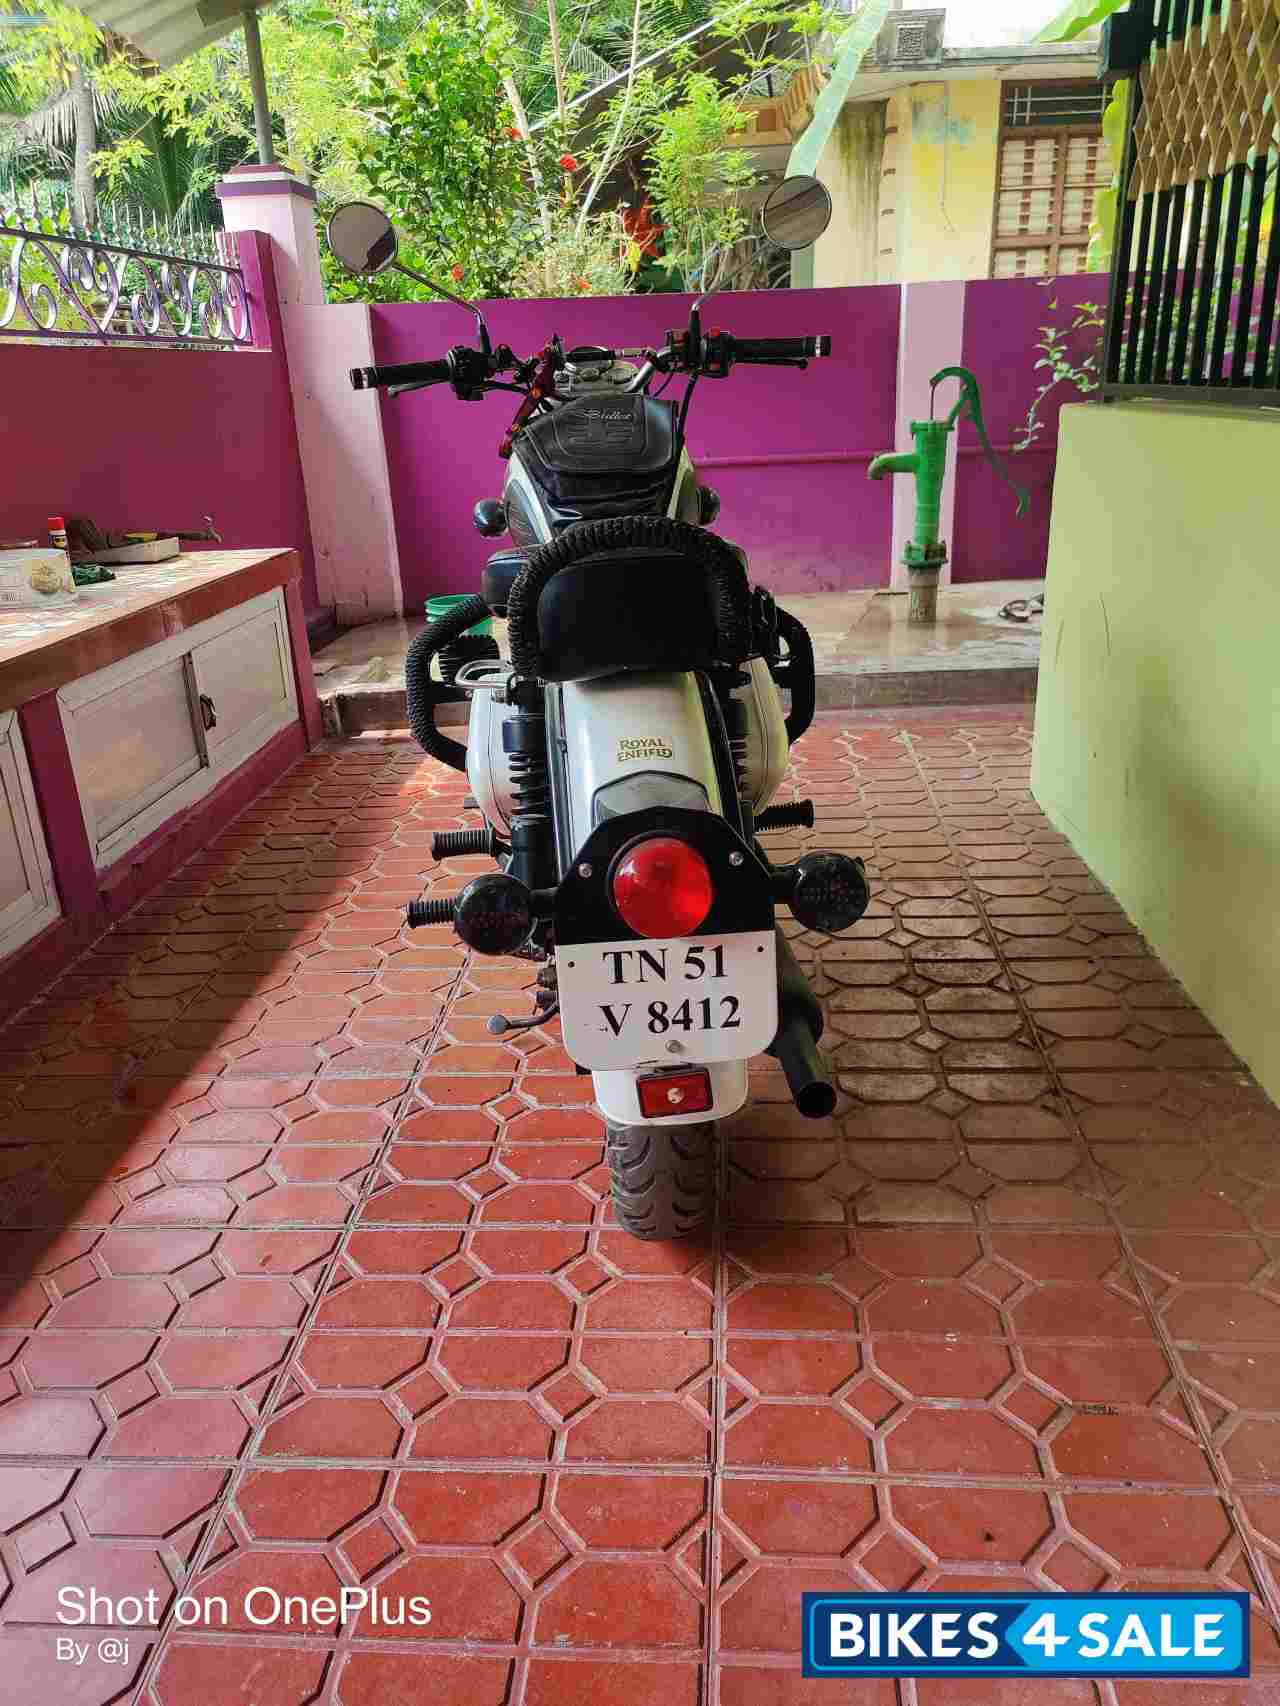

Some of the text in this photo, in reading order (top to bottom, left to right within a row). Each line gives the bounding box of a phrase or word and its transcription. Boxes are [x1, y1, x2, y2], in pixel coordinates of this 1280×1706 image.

[602, 944, 727, 985] TN 51
[597, 995, 741, 1037] V 8412
